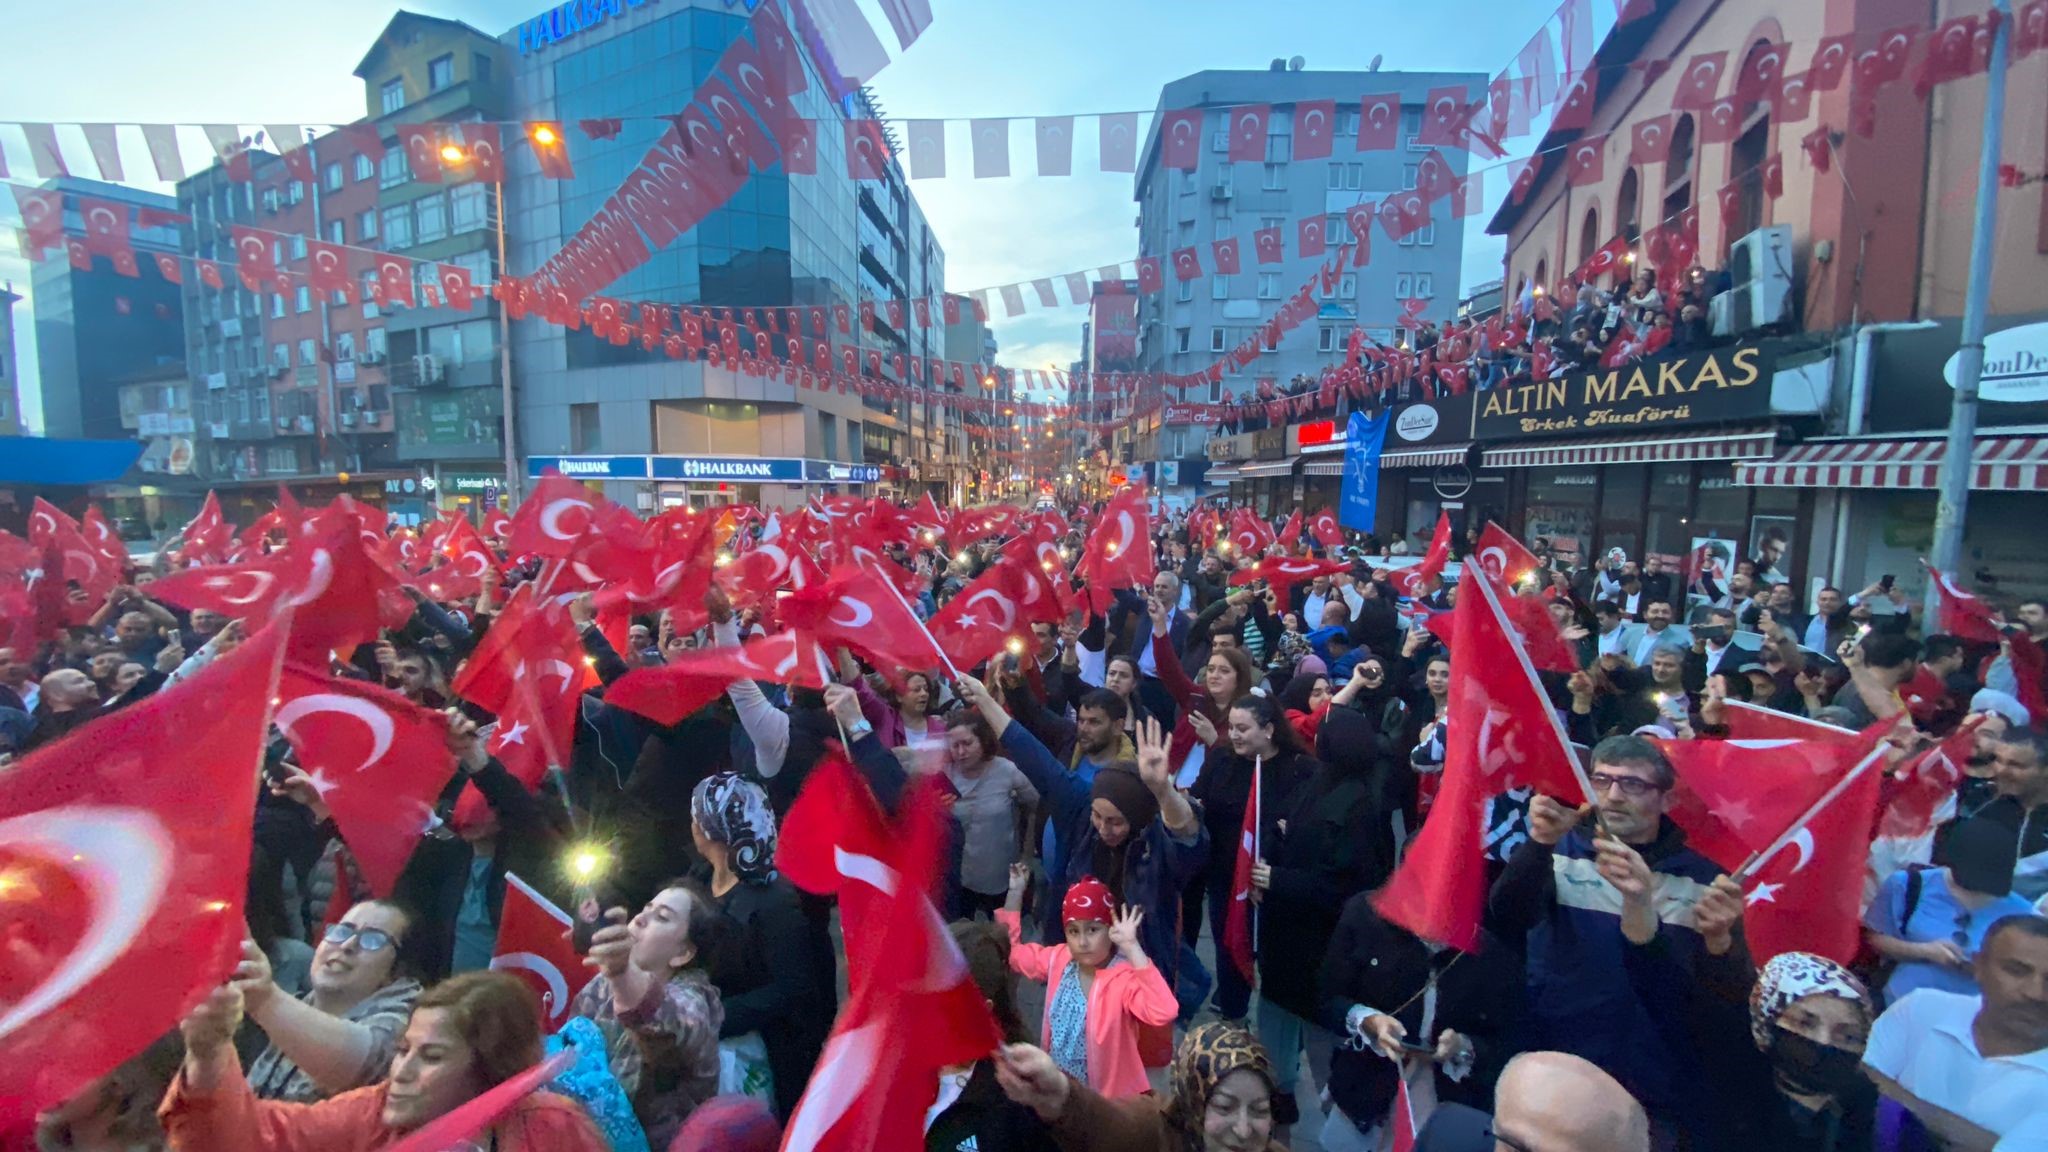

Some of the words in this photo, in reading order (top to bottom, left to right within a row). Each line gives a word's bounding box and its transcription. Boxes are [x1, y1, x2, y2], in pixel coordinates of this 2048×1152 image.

[1983, 350, 2048, 374] onDe
[1482, 379, 1568, 418] ALTIN
[1584, 347, 1760, 405] MAKAS
[1520, 414, 1578, 433] Erkek
[1584, 405, 1691, 427] Kuaförü
[567, 461, 611, 473] HALKBANK
[700, 463, 772, 475] HALKBANK
